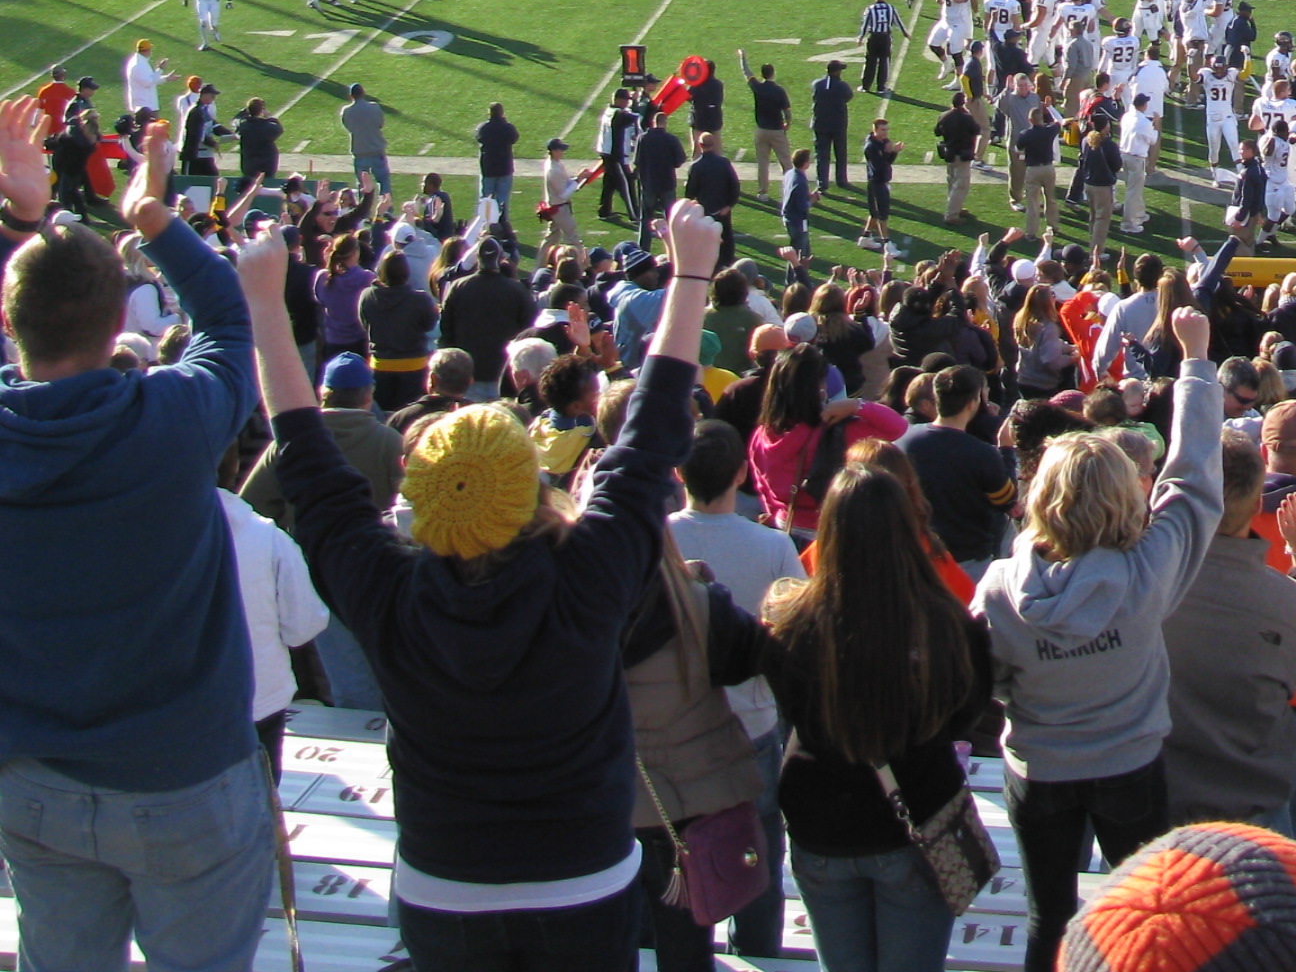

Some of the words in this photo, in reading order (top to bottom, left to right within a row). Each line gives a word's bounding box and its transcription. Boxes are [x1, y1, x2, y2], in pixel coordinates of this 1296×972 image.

[304, 29, 454, 55] 10
[626, 49, 639, 73] 1
[1113, 46, 1134, 62] 23
[1210, 88, 1227, 102] 31
[1280, 152, 1289, 167] 3
[295, 745, 346, 763] 20
[339, 785, 391, 804] 19
[312, 874, 373, 899] 18
